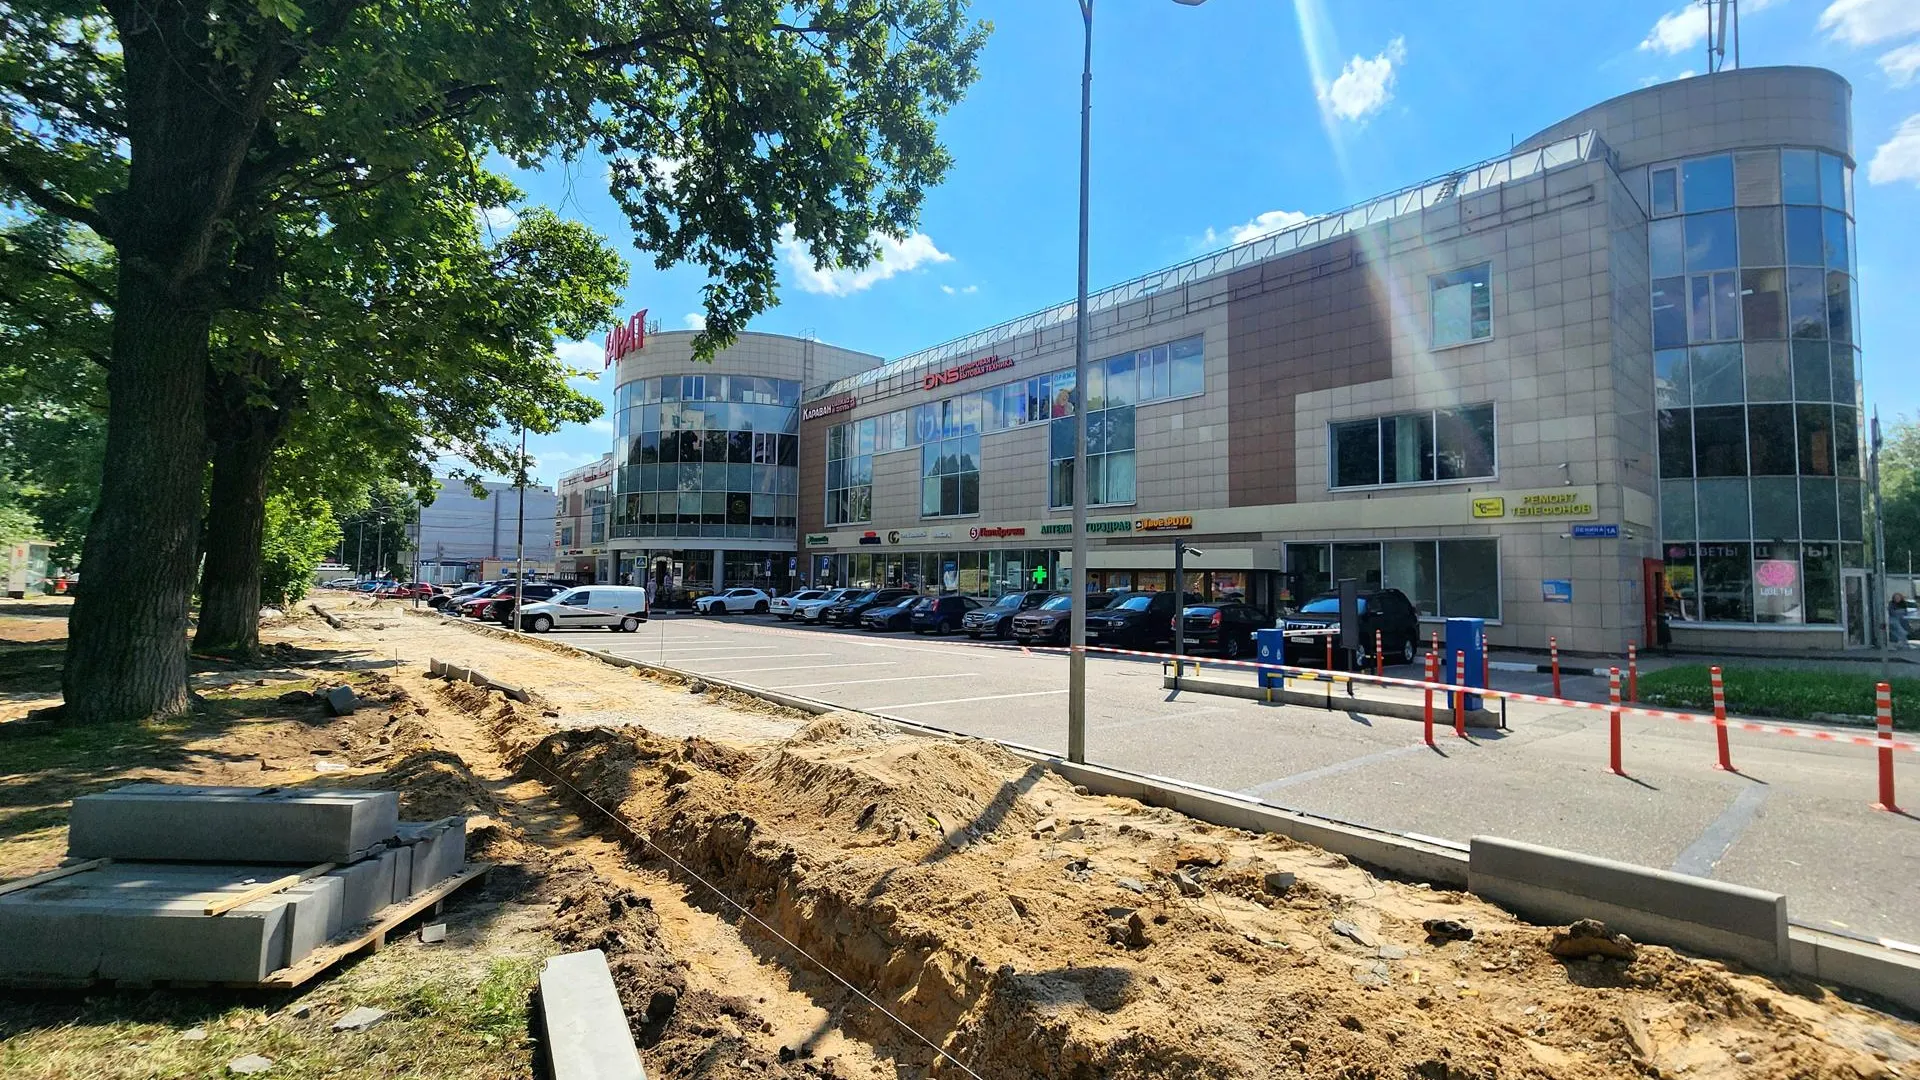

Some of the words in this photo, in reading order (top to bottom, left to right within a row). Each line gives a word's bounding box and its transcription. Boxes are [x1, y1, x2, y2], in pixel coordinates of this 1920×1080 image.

[923, 366, 960, 391] DNS
[1524, 493, 1577, 504] РЕМОНТ
[1511, 503, 1592, 517] ТЕЛЕФОНОВ
[1086, 521, 1131, 533] ГОРЗДРАВ
